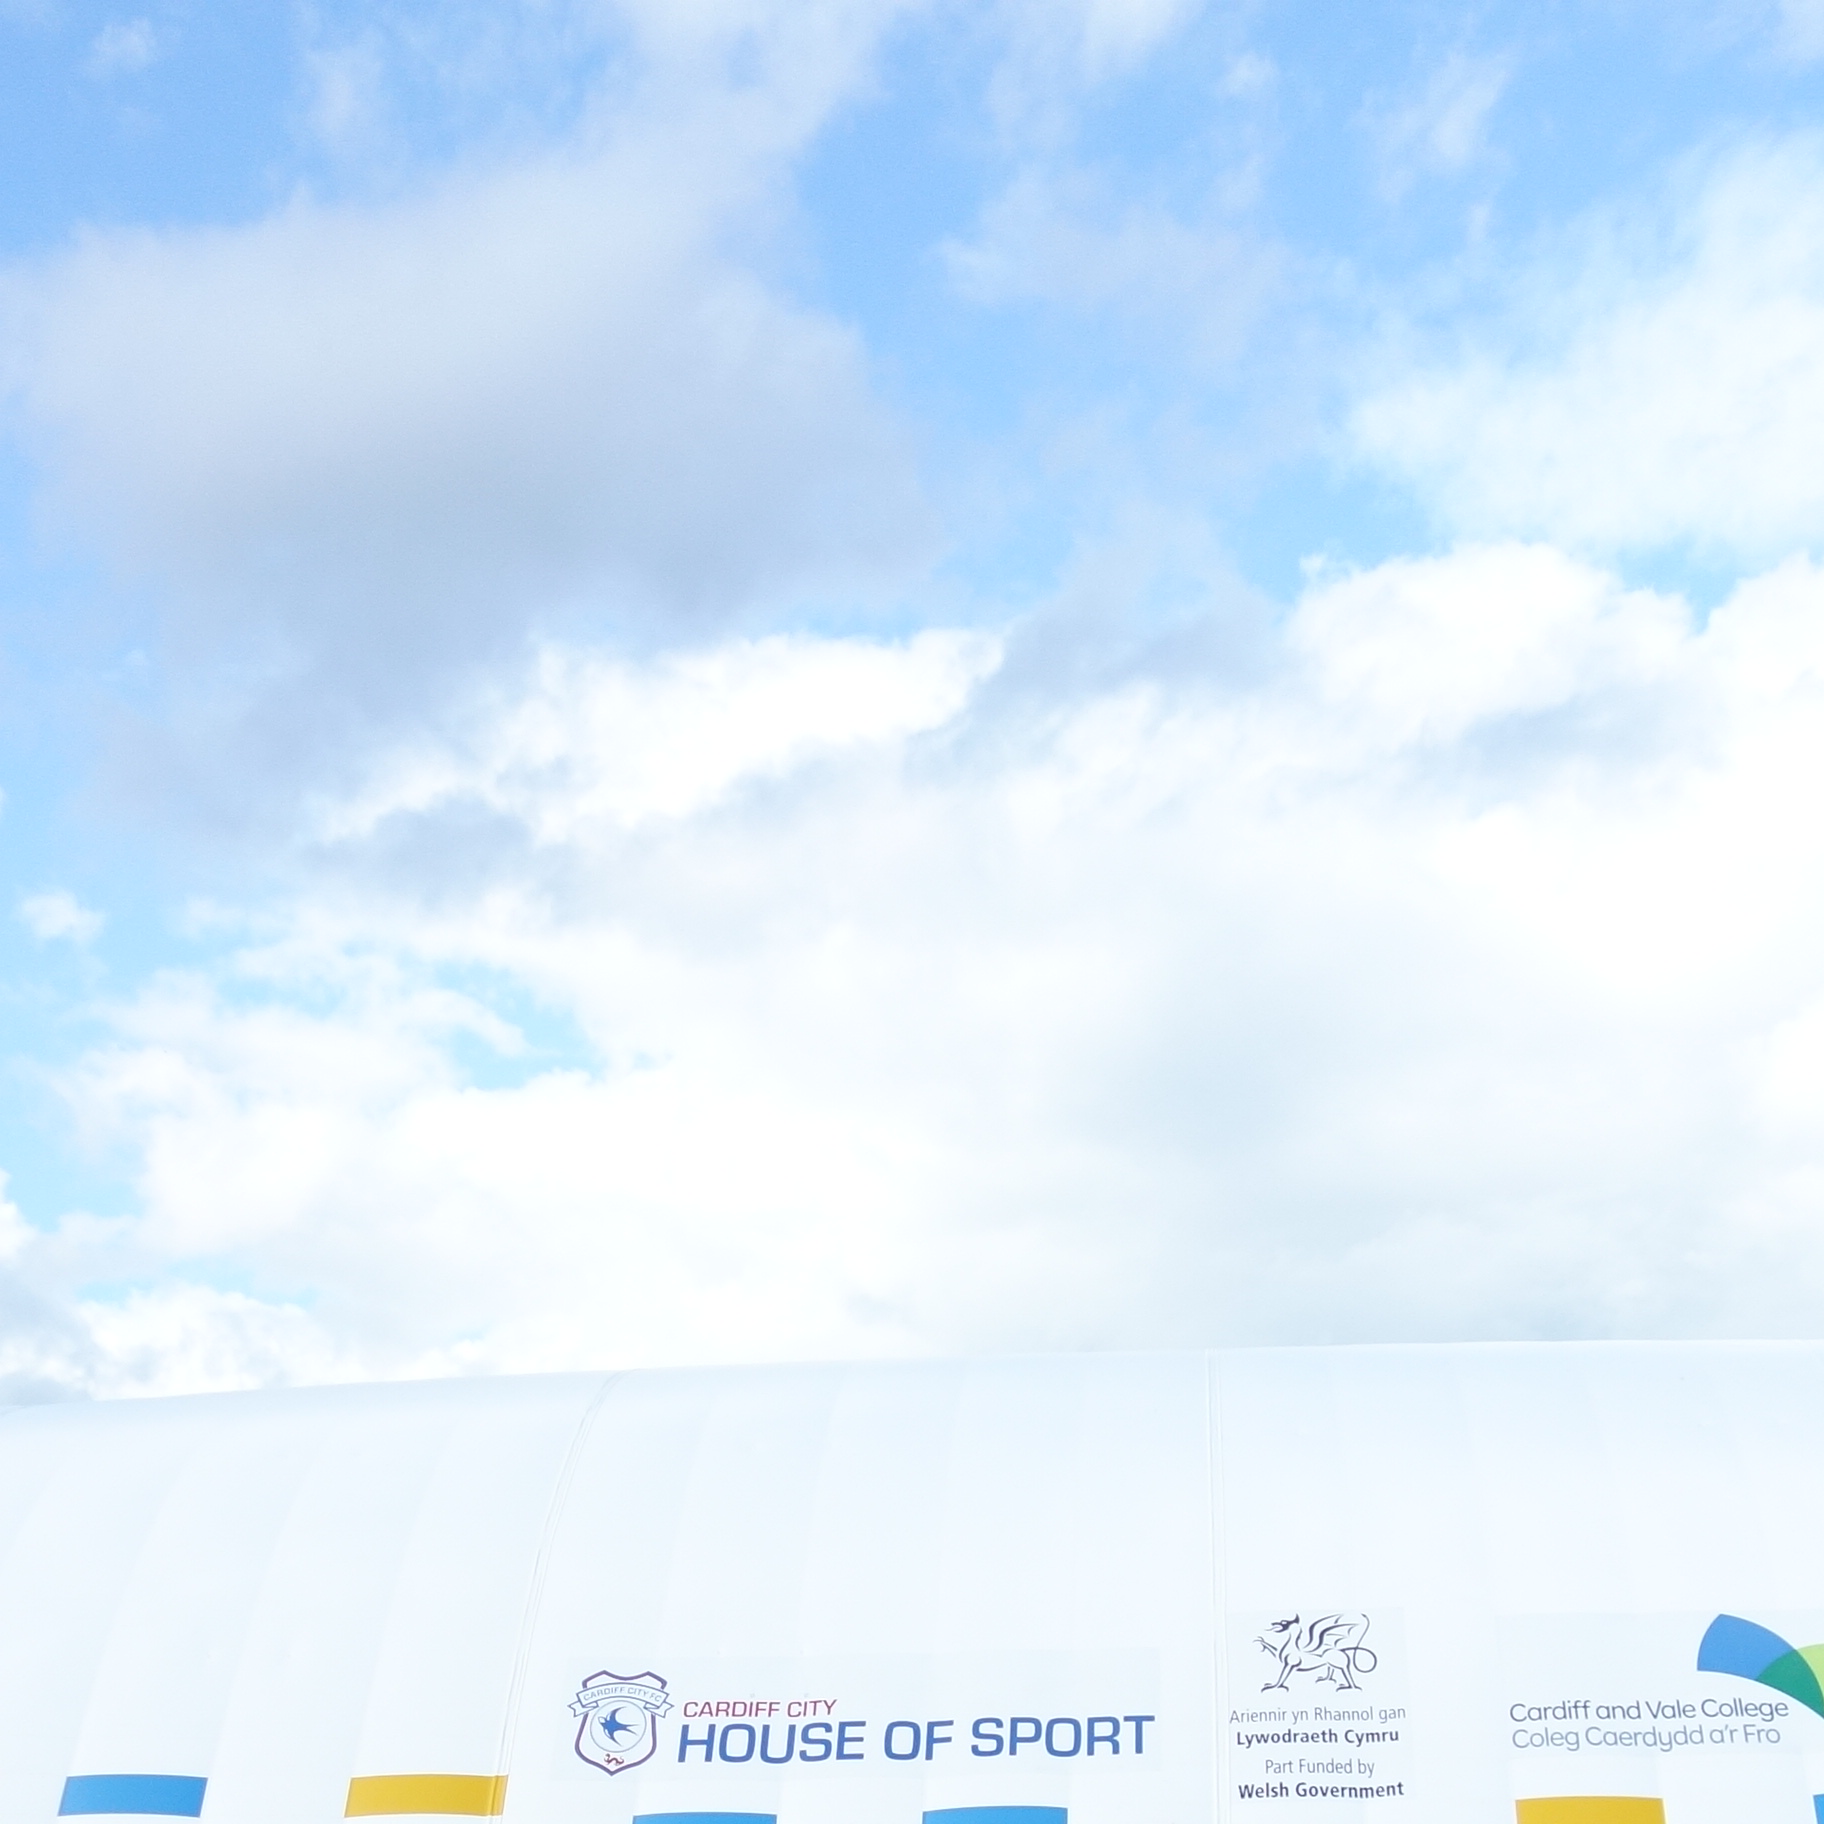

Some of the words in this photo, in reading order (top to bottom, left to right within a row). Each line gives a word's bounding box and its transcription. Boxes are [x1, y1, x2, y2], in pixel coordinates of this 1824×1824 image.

[583, 1686, 625, 1701] CARDIFF
[627, 1687, 648, 1697] CITY
[650, 1692, 663, 1702] FC
[682, 1700, 781, 1718] CARDIFF
[786, 1698, 838, 1718] CITY
[1229, 1707, 1288, 1724] Ariennir
[1291, 1710, 1309, 1725] yn
[1314, 1705, 1374, 1721] Rhannol
[1378, 1707, 1407, 1724] gan
[1509, 1699, 1591, 1722] Cardiff
[1595, 1699, 1642, 1720] and
[1644, 1699, 1697, 1720] Vale
[1701, 1697, 1790, 1722] College
[677, 1720, 867, 1764] HOUSE
[883, 1719, 954, 1761] OF
[970, 1714, 1156, 1758] SPORT
[1236, 1728, 1339, 1749] Lywodraeth
[1344, 1729, 1399, 1747] Cymru
[1511, 1727, 1581, 1752] Coleg
[1584, 1725, 1705, 1752] Caerdydd
[1709, 1724, 1739, 1745] a'r
[1742, 1724, 1781, 1744] Fro
[1265, 1759, 1294, 1774] Part
[1298, 1757, 1353, 1774] Funded
[1357, 1758, 1375, 1778] by
[1238, 1782, 1290, 1799] Welsh
[1295, 1781, 1405, 1799] Government
